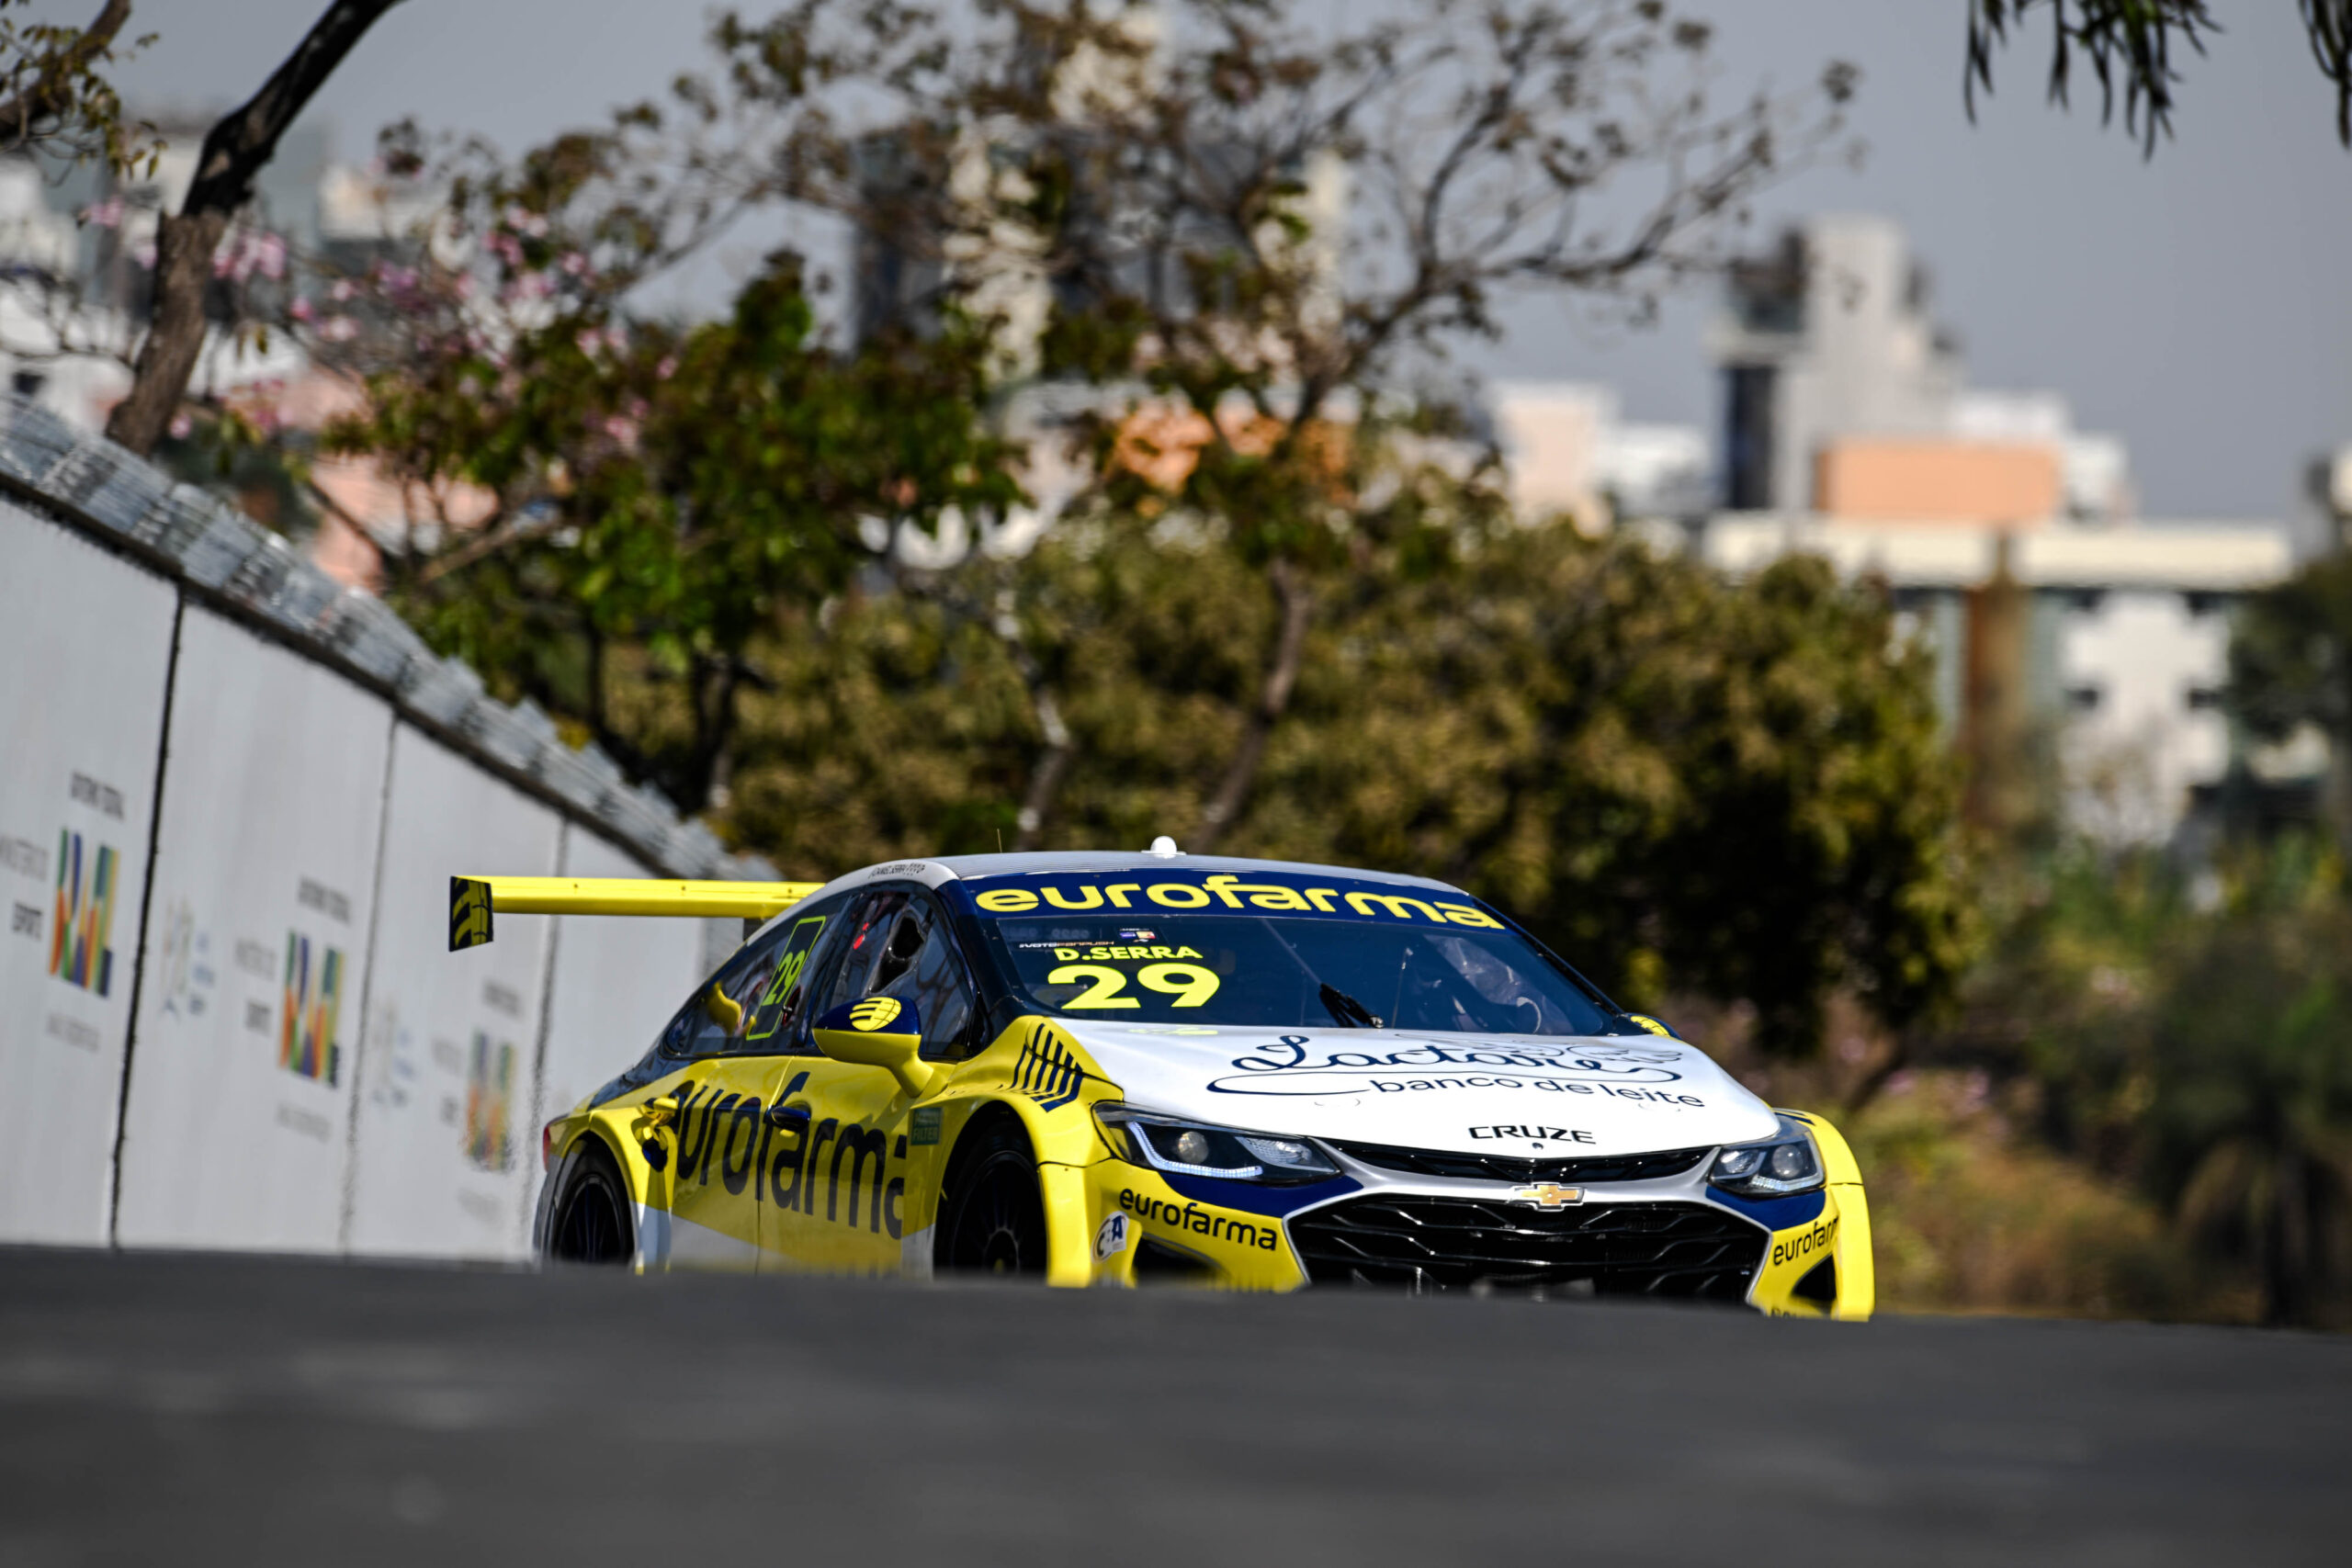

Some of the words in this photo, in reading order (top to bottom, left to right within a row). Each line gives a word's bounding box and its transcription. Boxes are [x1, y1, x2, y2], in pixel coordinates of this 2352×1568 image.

[976, 875, 1505, 930] eurofarma
[1054, 946, 1204, 961] D.SERRA
[762, 950, 806, 1006] 29
[1047, 963, 1220, 1010] 29
[1369, 1077, 1523, 1092] banco
[1534, 1079, 1594, 1094] de
[1598, 1083, 1705, 1108] leite
[1468, 1124, 1598, 1145] CRUZE
[1119, 1188, 1278, 1251] eurofarma
